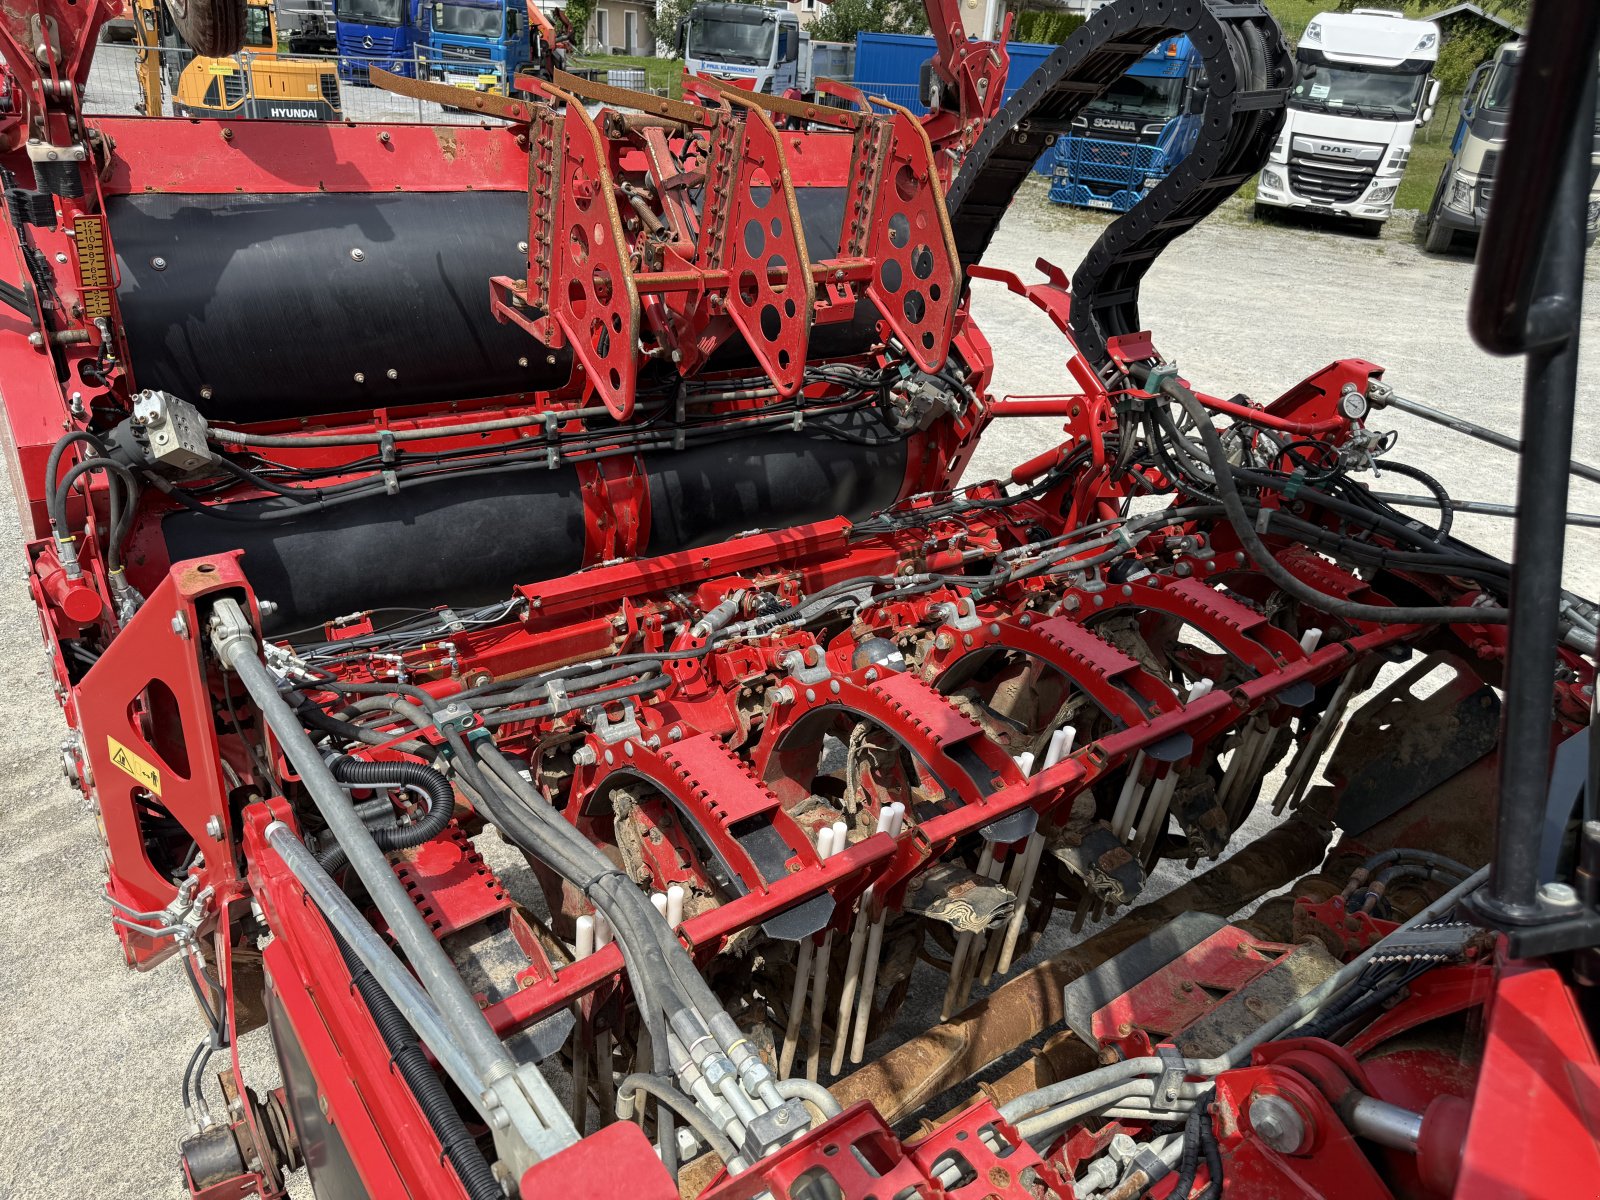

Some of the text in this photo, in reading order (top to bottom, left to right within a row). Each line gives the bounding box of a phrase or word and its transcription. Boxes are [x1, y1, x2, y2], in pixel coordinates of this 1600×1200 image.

[271, 108, 318, 118] HYUNDAI
[1093, 118, 1136, 130] SCANIA
[1320, 144, 1352, 153] DAF
